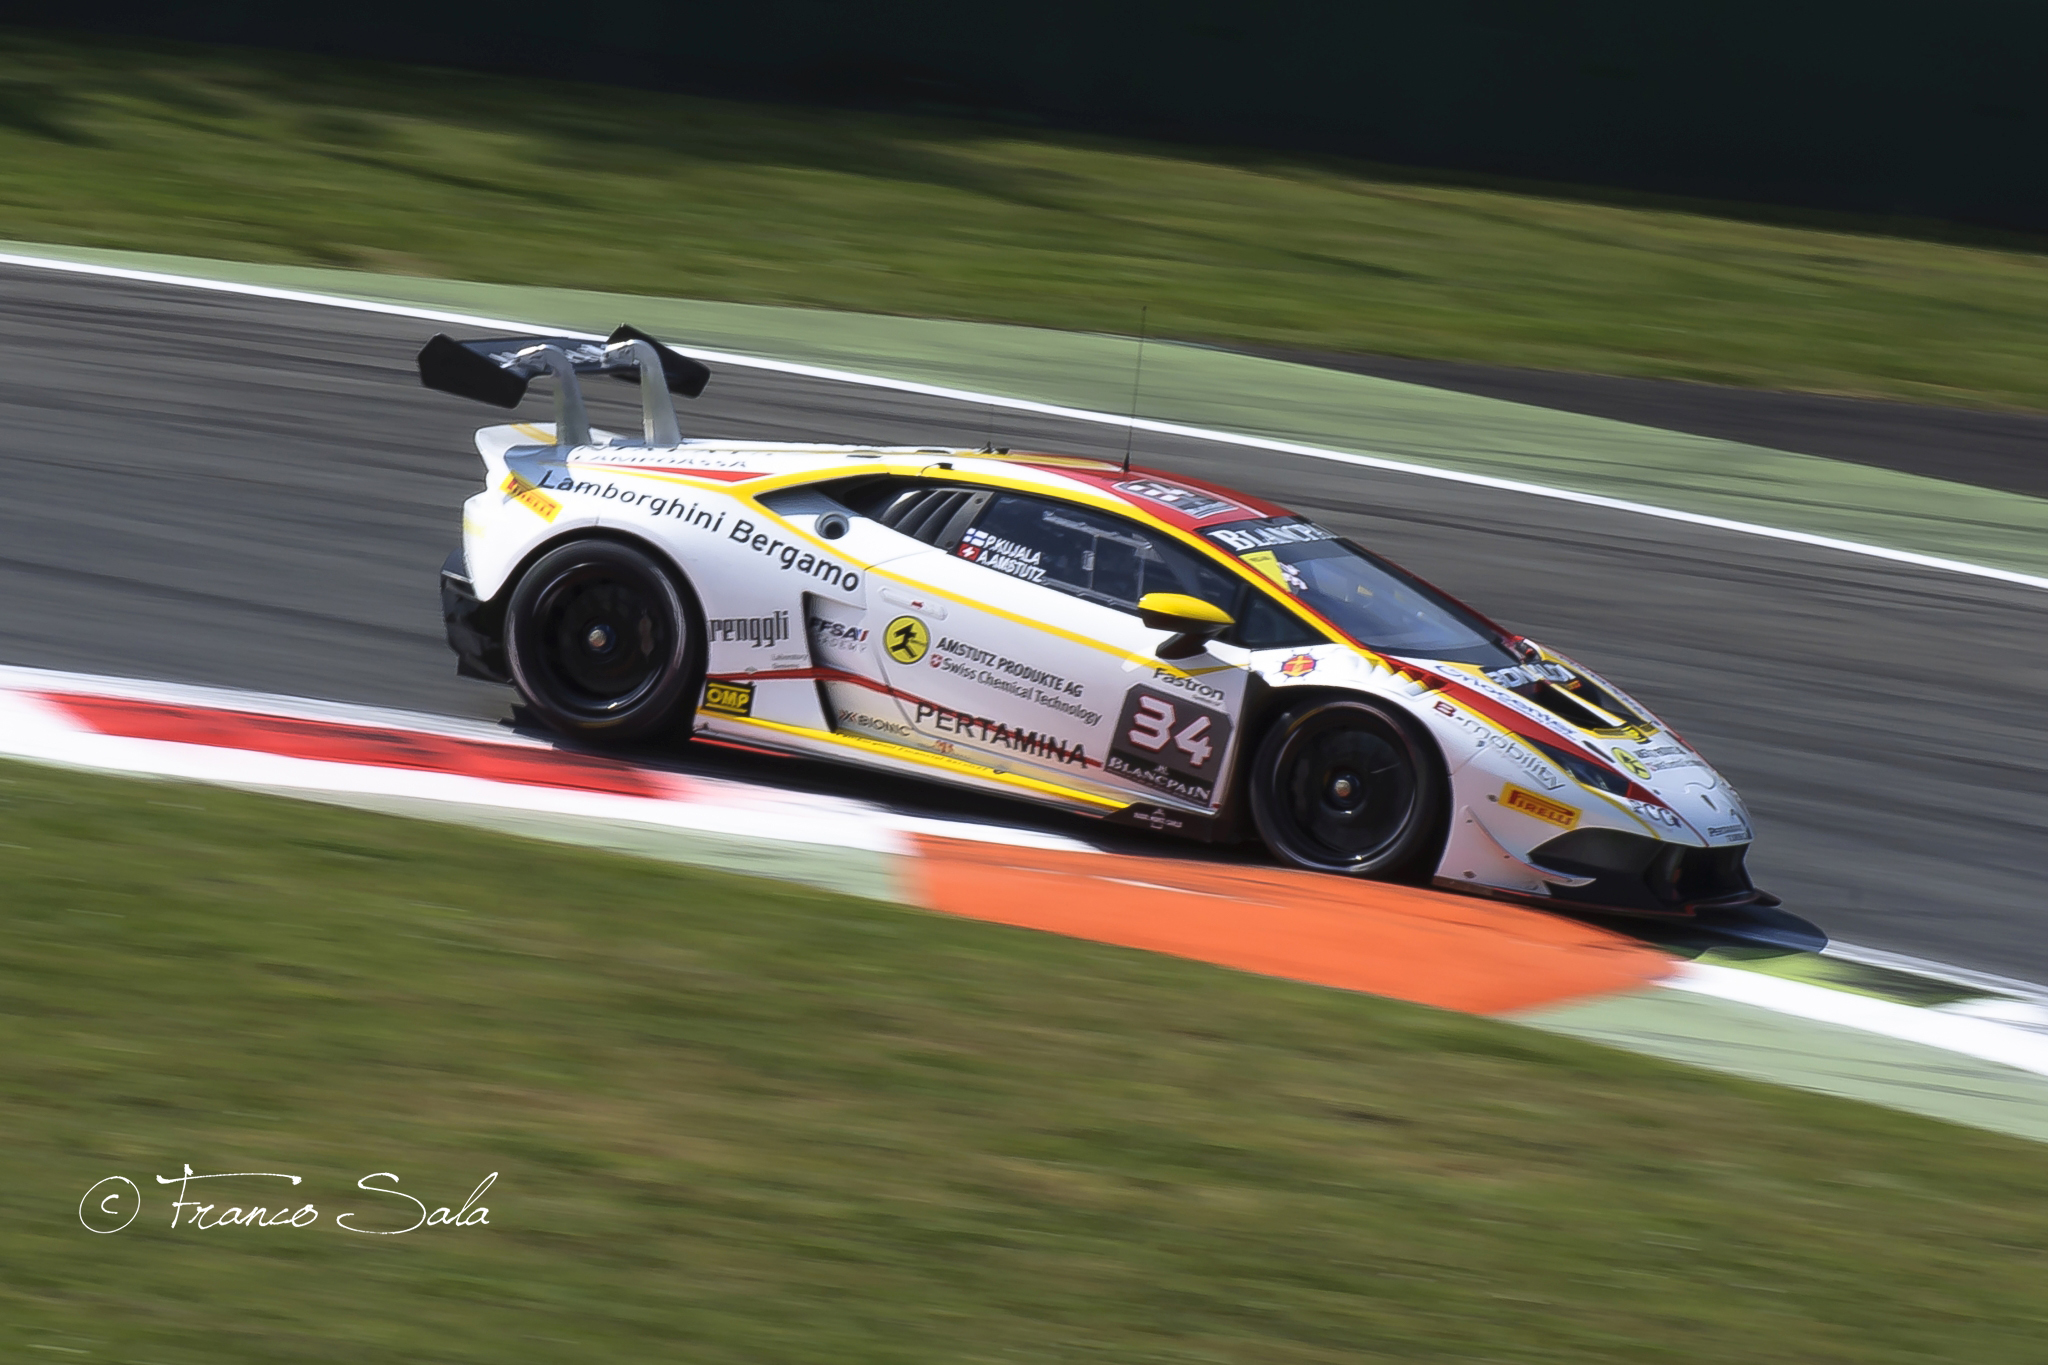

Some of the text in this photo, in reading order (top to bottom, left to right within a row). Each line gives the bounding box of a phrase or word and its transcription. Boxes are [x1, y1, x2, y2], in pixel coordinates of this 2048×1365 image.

[537, 469, 860, 592] Lamborghini Bergamo
[708, 609, 790, 649] renggli
[936, 636, 1084, 698] AMSTUTZ PRODUKTE AG
[941, 656, 1104, 729] Swiss Chemical Technology
[1153, 667, 1226, 701] Fastron
[706, 687, 750, 709] OMP
[915, 702, 1089, 770] PERTAMINA
[1128, 693, 1214, 768] 34
[1109, 756, 1211, 801] BLANCPAIN
[1508, 789, 1576, 826] PIRELLI
